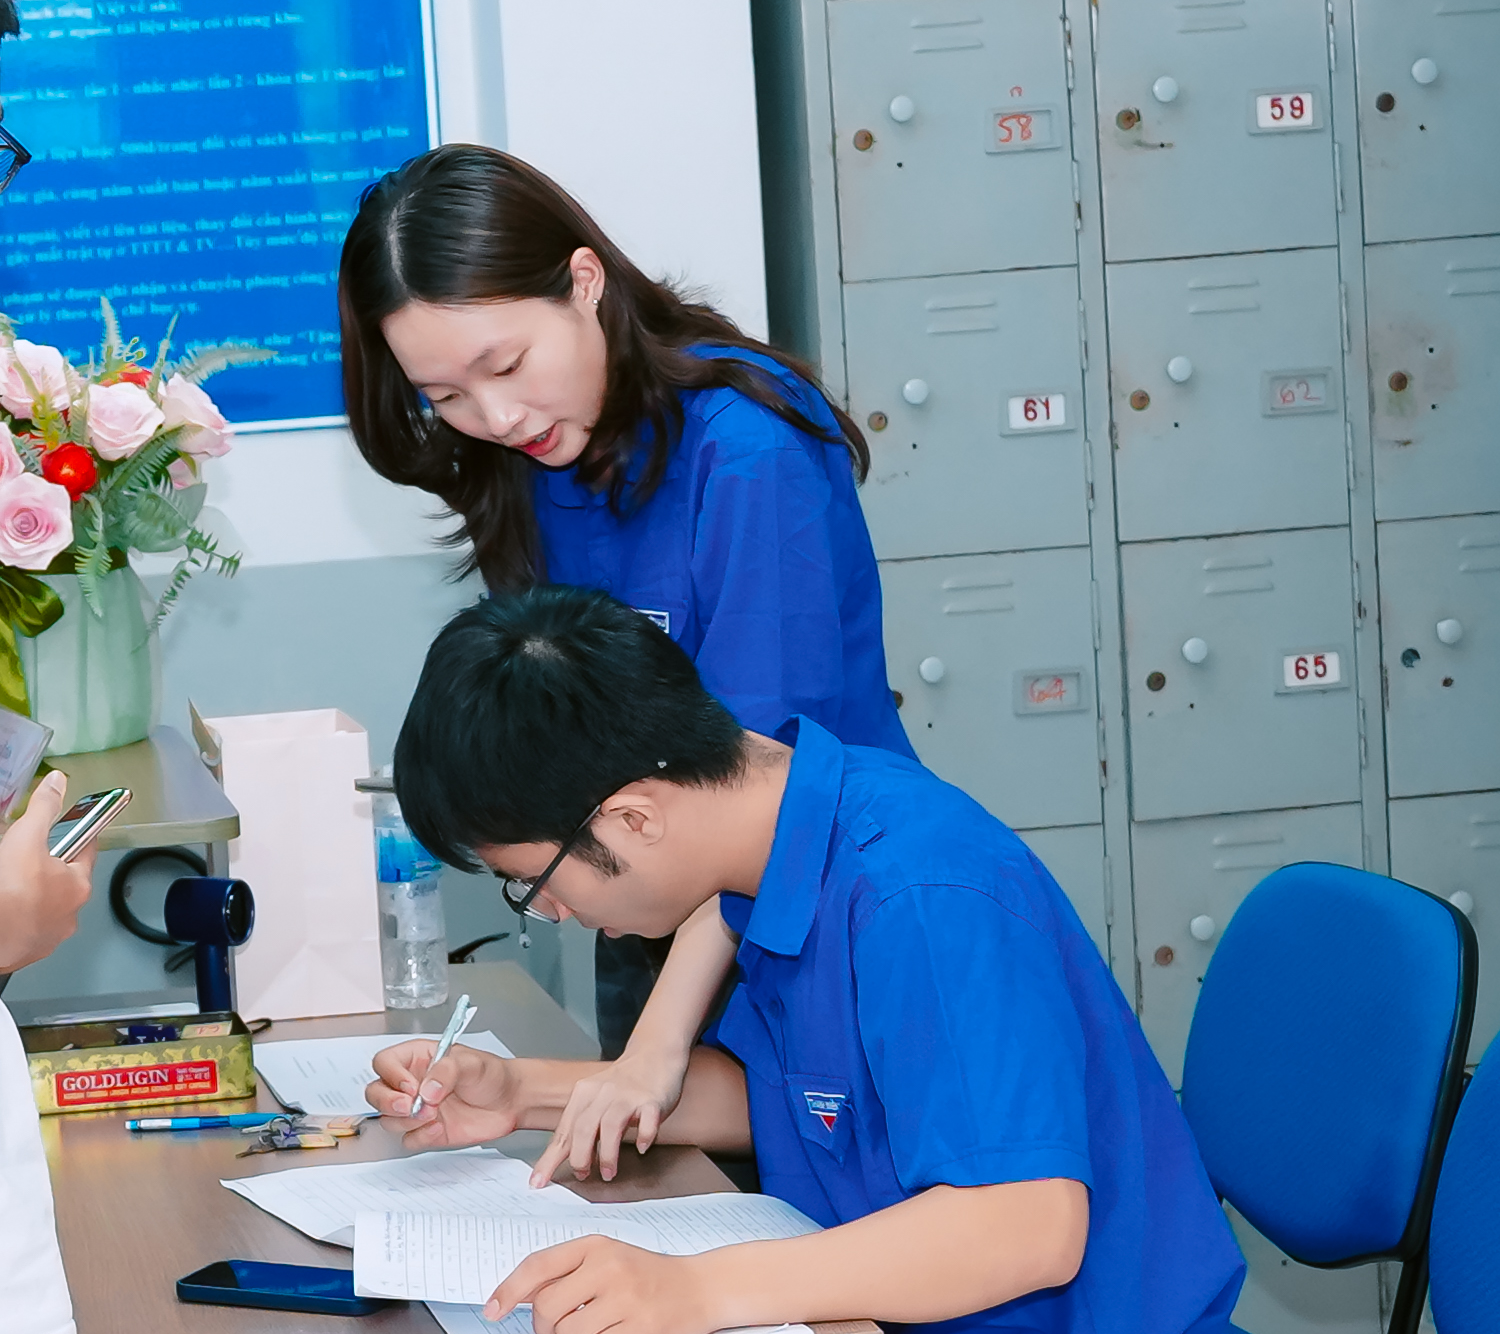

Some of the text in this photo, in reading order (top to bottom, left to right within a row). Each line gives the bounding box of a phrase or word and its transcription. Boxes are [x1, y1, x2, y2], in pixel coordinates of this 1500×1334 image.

[1268, 94, 1306, 122] 59
[997, 113, 1033, 144] 58
[1278, 381, 1317, 405] 62
[1293, 653, 1329, 680] 65
[62, 1069, 169, 1091] GOLDLIGIN
